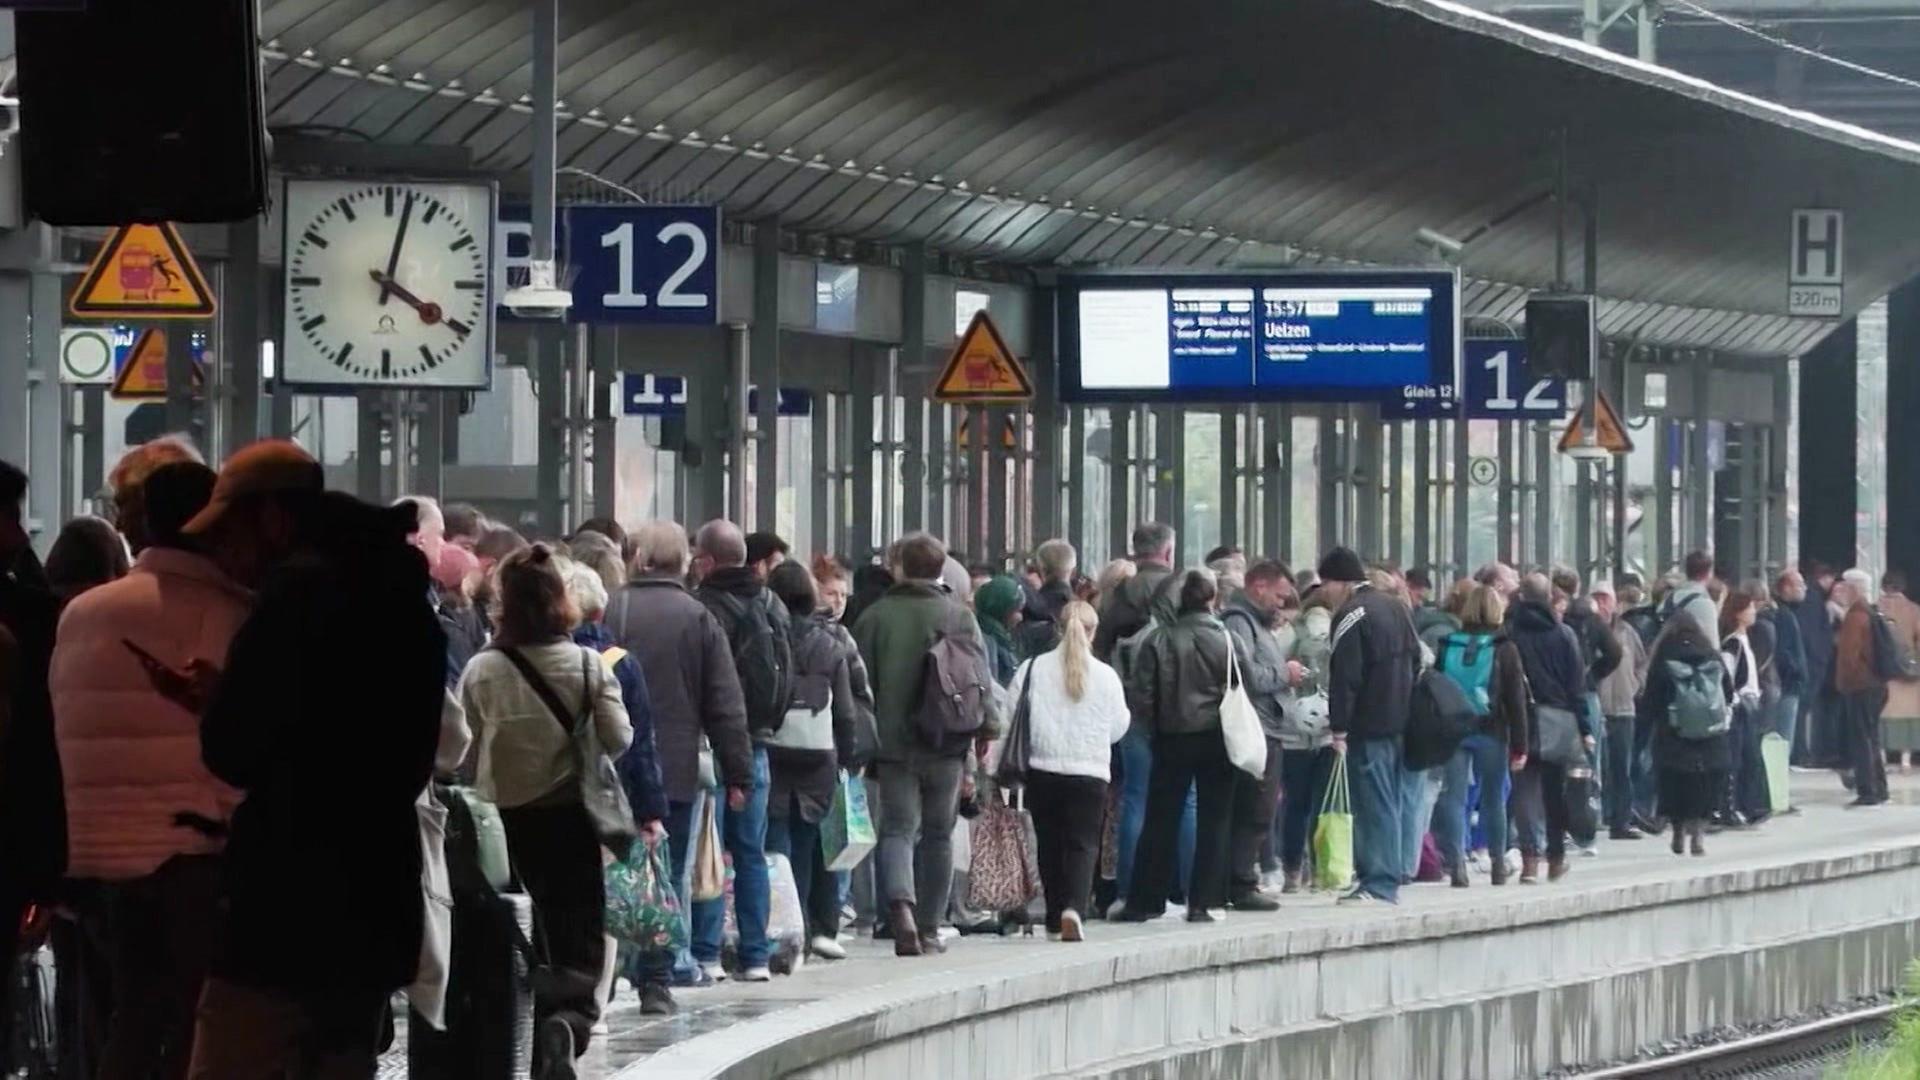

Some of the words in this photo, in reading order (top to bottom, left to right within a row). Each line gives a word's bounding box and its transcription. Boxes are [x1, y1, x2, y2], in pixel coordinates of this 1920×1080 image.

[601, 221, 708, 307] 12
[1797, 214, 1837, 277] H
[1265, 322, 1310, 338] Uelzen
[1403, 384, 1436, 398] Gleis
